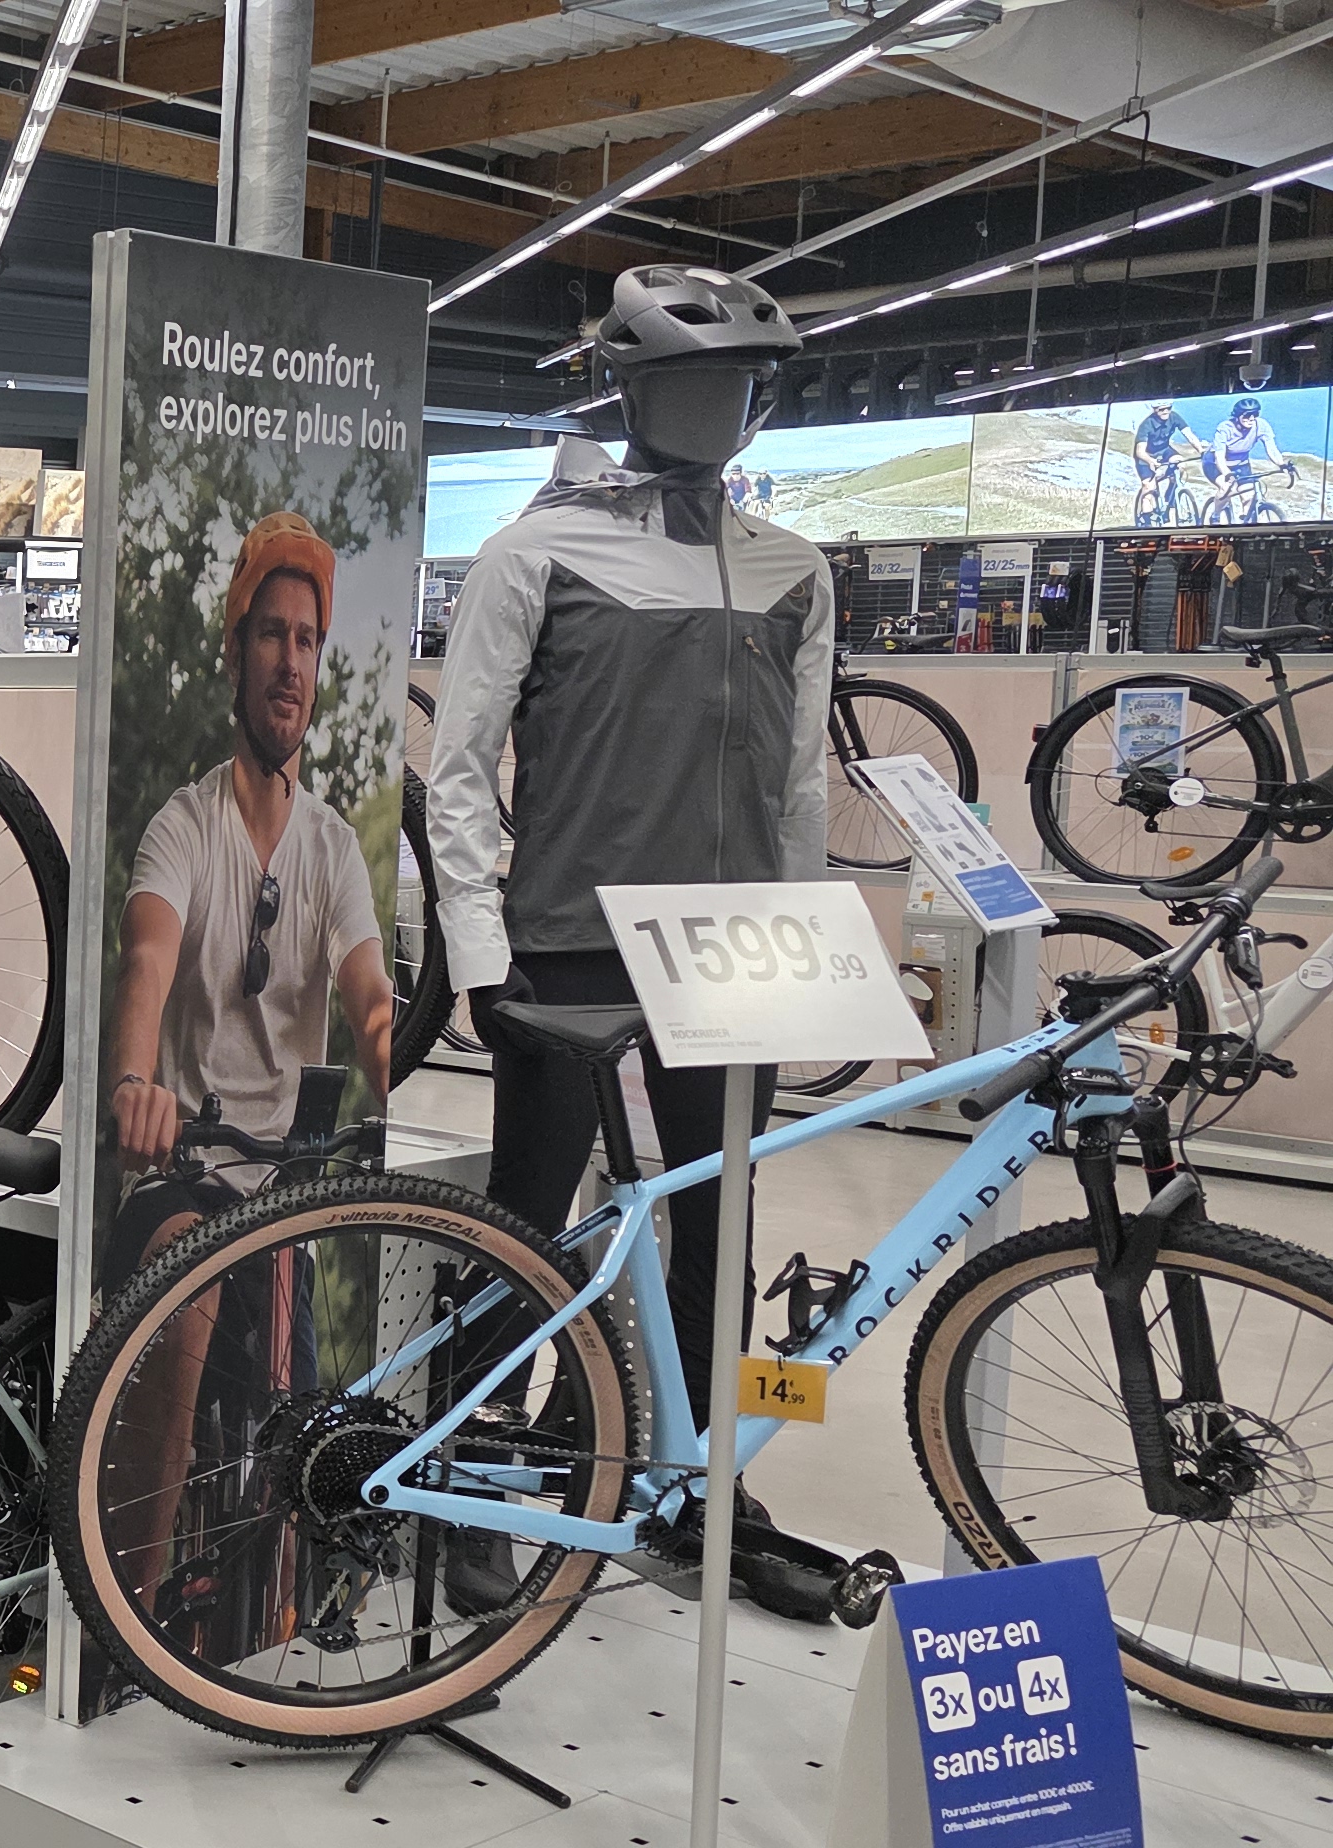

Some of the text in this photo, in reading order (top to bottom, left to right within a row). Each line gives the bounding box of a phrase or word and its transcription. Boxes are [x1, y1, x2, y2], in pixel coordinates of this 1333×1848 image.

[162, 321, 380, 400] Roulez confort,
[159, 392, 407, 453] explorez plus loin
[983, 559, 1030, 571] 23/25mm
[669, 1028, 731, 1040] ROCKRIDER
[340, 1210, 483, 1243] vittoria MEZCAL
[827, 1130, 1052, 1366] ROCKRIDER
[912, 1619, 1041, 1664] Payez en
[929, 1670, 1064, 1719] 3x ou 4x
[933, 1745, 1000, 1780] sans
[941, 1807, 960, 1819] Pour
[960, 1806, 970, 1815] un
[970, 1802, 990, 1814] achat
[990, 1795, 1019, 1810] compris
[1058, 1786, 1067, 1796] et
[942, 1823, 964, 1834] Offre
[989, 1809, 1031, 1826] uniquement
[1031, 1807, 1041, 1817] en
